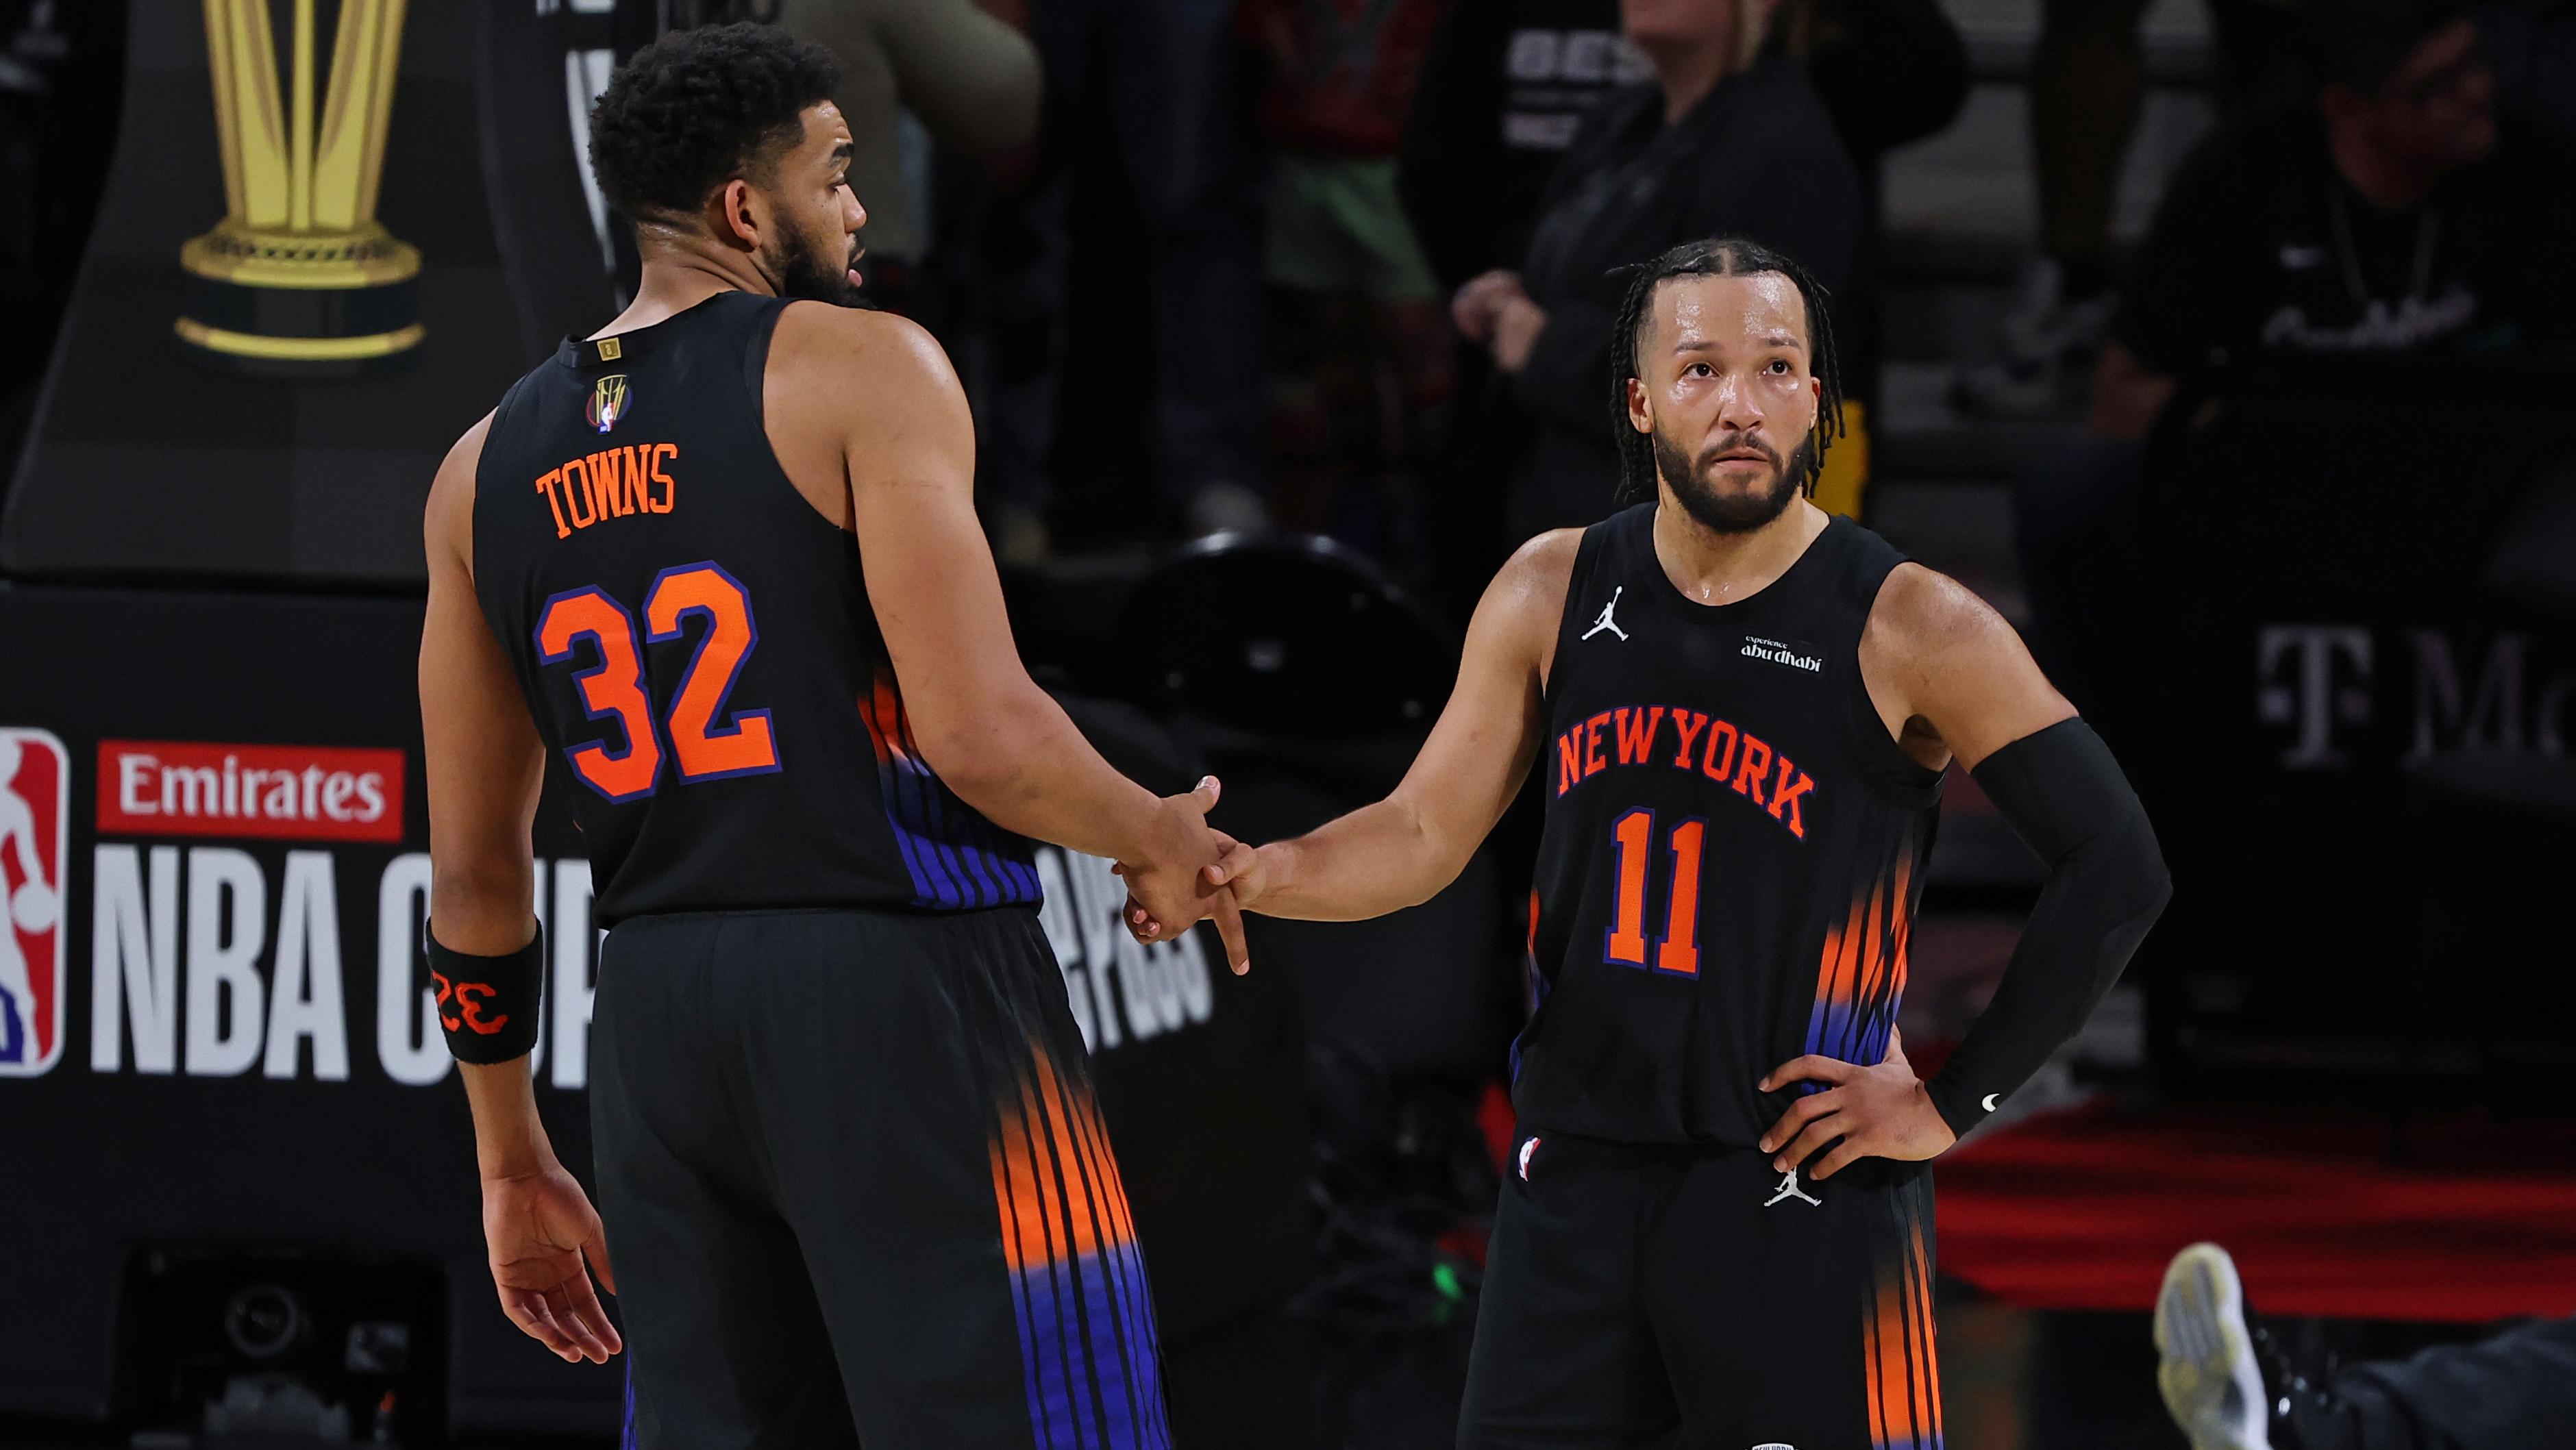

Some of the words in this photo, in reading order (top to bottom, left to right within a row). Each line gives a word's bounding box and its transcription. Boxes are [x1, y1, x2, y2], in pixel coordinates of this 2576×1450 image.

[534, 442, 680, 540] TOWNS
[532, 559, 783, 805] 32
[1741, 644, 1772, 660] abu
[1774, 650, 1822, 673] dhabi
[1745, 635, 1788, 649] experience
[117, 752, 387, 823] Emirates
[1556, 705, 1665, 799] NEW
[1670, 706, 1819, 842] YORK
[1602, 805, 1709, 981] 11
[90, 842, 351, 1083] NBA
